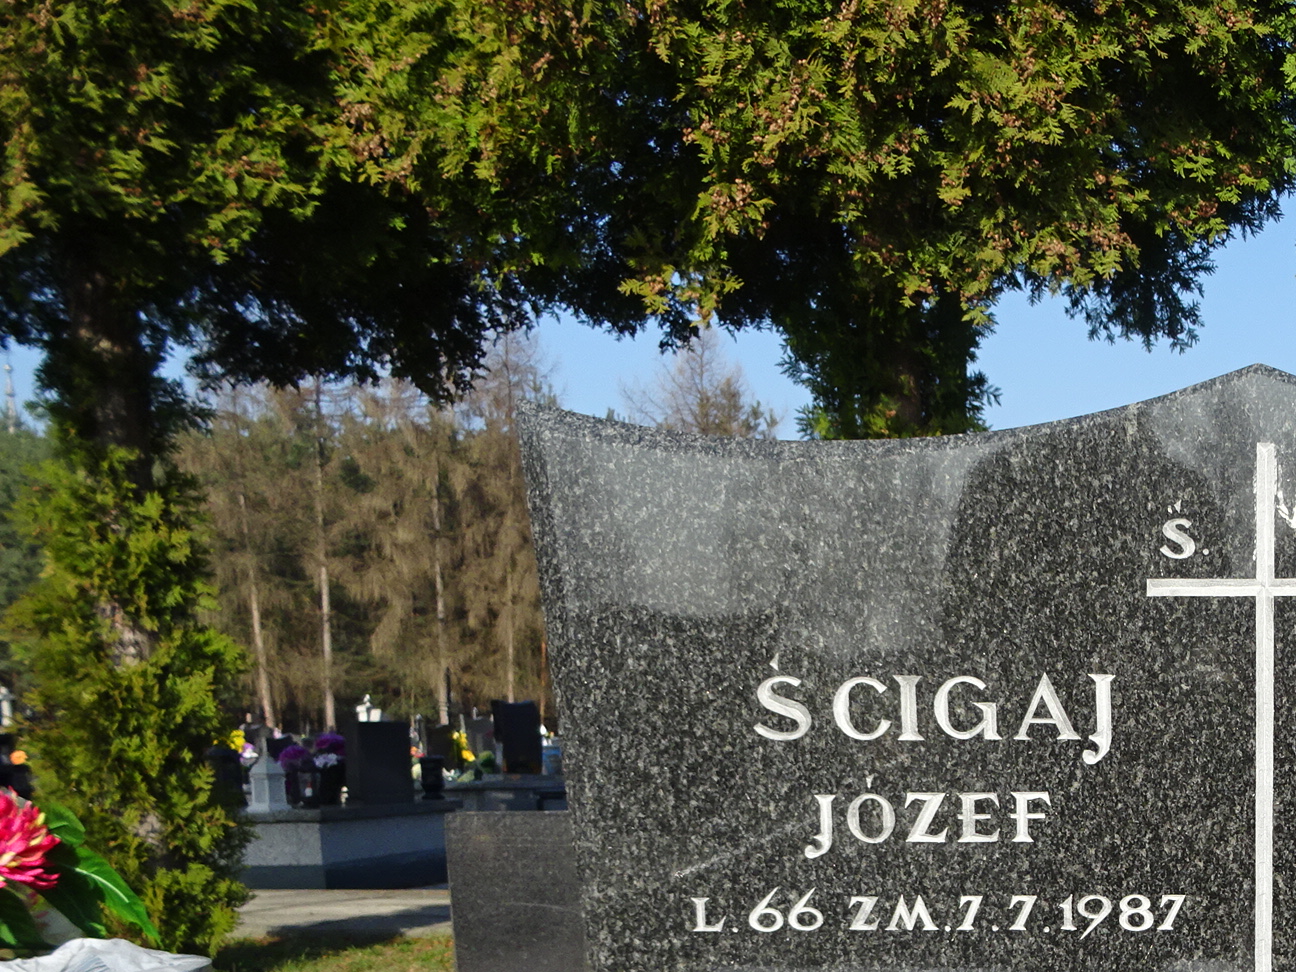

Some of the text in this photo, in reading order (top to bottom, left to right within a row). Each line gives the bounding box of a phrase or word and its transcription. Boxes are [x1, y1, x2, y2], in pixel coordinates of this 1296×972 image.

[752, 654, 1117, 765] ŚCIGAJ
[804, 775, 1052, 860] JÓZEF
[691, 886, 824, 933] L.66
